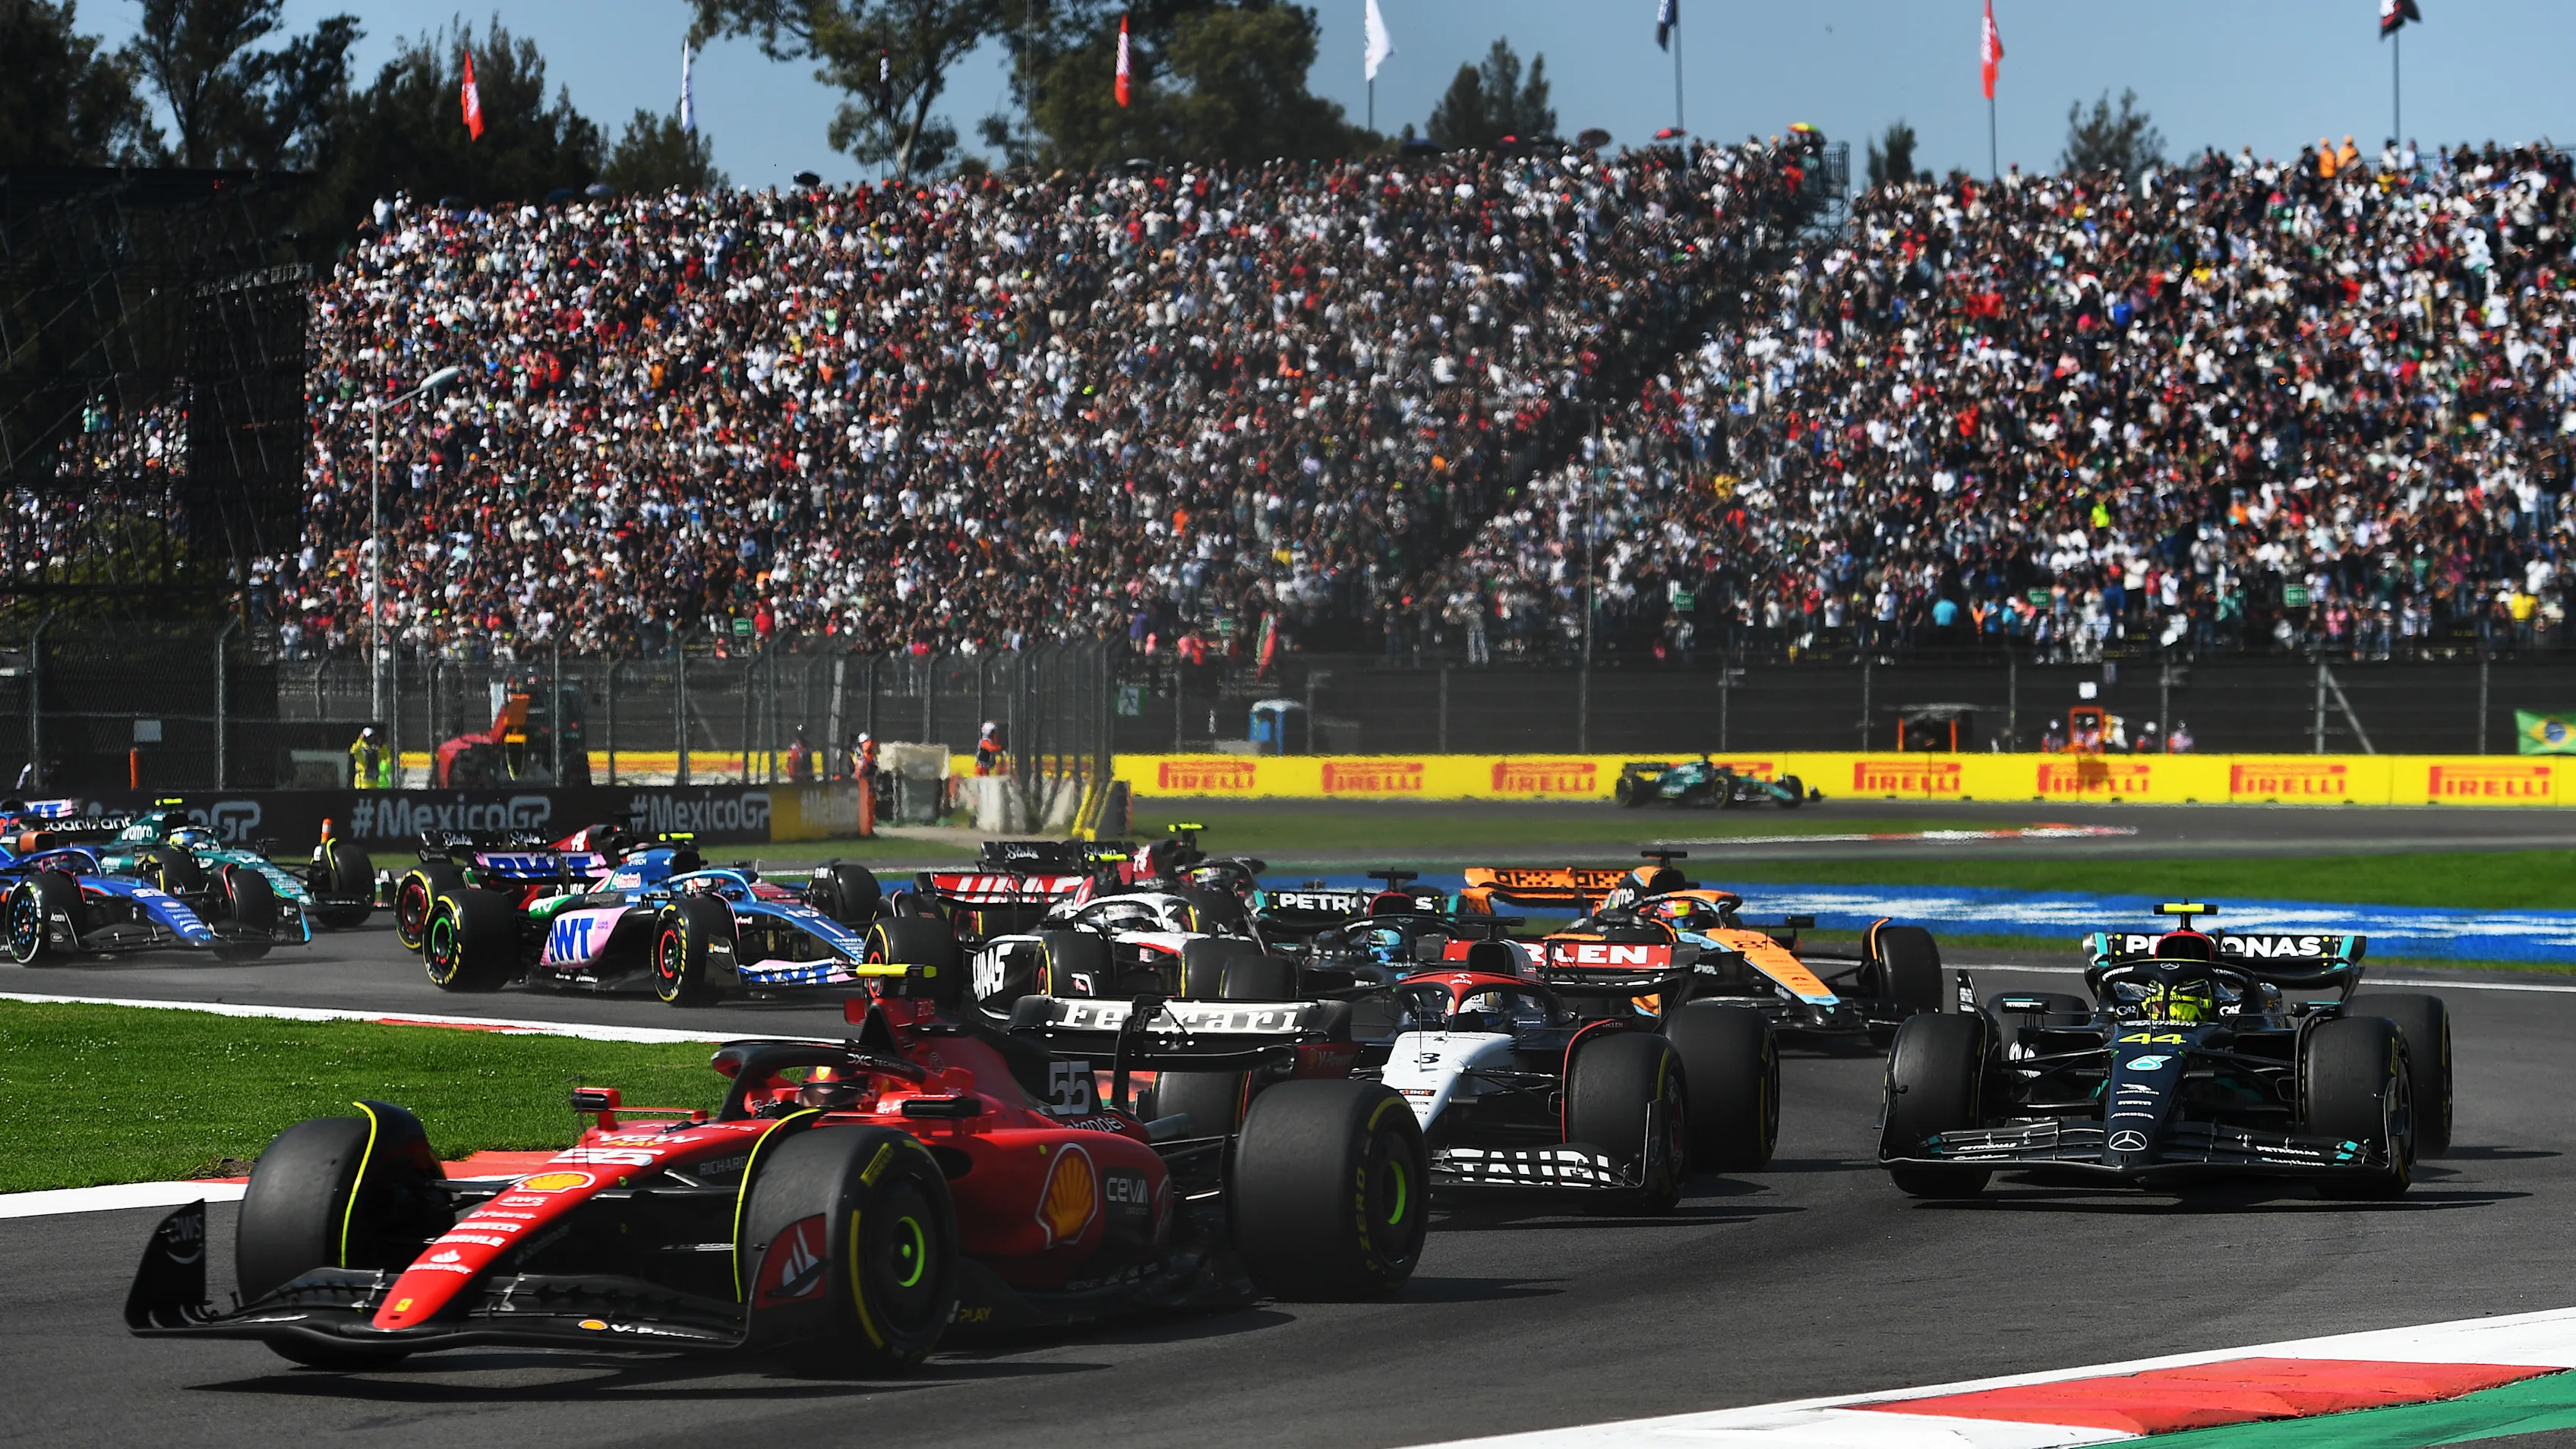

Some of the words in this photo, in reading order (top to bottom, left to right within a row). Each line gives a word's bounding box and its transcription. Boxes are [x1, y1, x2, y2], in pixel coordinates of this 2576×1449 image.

[1158, 762, 1255, 790] PIRELLI
[1322, 762, 1423, 792] PIRELLI
[1492, 762, 1596, 791] PIRELLI
[1854, 762, 1962, 791] PIRELLI
[2038, 763, 2149, 794] PIRELLI
[2230, 765, 2346, 794] PIRELLI
[2429, 766, 2550, 796] PIRELLI
[351, 796, 551, 835] #MexicoGP
[630, 791, 772, 832] #MexicoGP
[443, 832, 473, 846] Stake
[1005, 843, 1039, 860] Stake
[617, 873, 641, 889] Castrol
[1280, 892, 1434, 916] PETROS
[1517, 943, 1649, 964] RLEN
[2126, 936, 2321, 958] PONAS
[973, 942, 1007, 1002] HAAS
[1056, 999, 1302, 1031] Ferari
[2116, 1005, 2136, 1016] G42
[2118, 1032, 2187, 1045] 44
[847, 1053, 873, 1066] DXC
[1413, 1053, 1441, 1064] 3
[1050, 1061, 1091, 1115] 55
[598, 1134, 703, 1144] VGW
[547, 1148, 665, 1167] 55
[699, 1156, 747, 1176] RICHARD
[1448, 1148, 1612, 1189] TAURI
[501, 1196, 548, 1204] aws
[1355, 1166, 1371, 1252] ZERO
[436, 1235, 506, 1247] MAHLE
